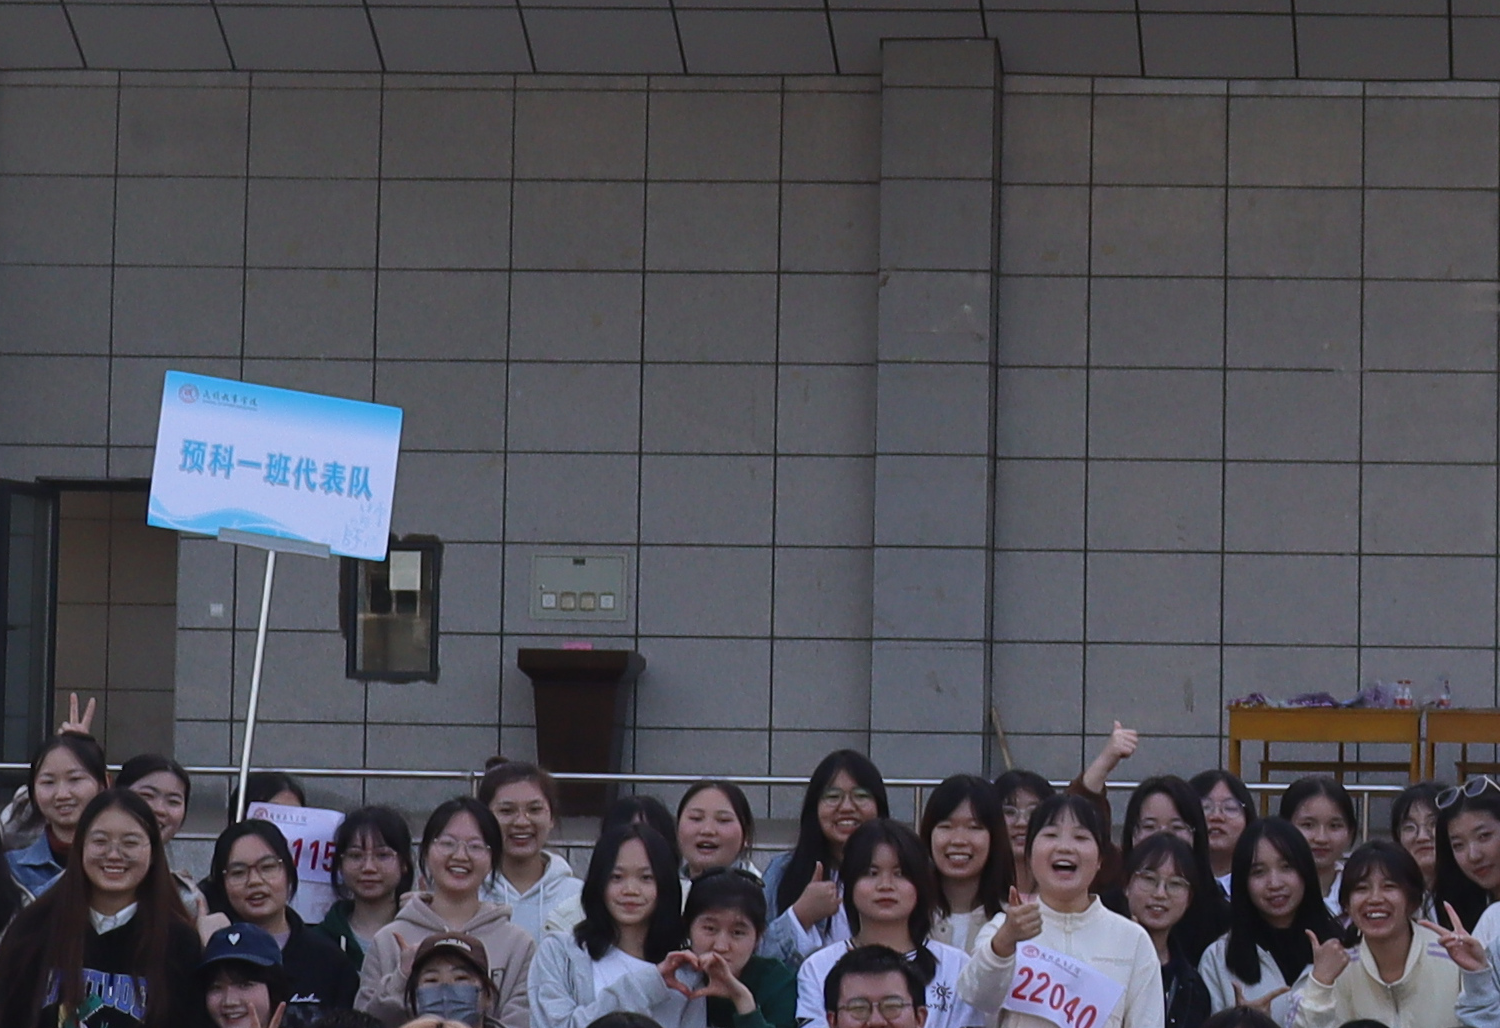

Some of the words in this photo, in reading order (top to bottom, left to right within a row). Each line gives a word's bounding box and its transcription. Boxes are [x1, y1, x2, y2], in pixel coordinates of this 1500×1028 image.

[179, 438, 375, 501] 预科一班代表队
